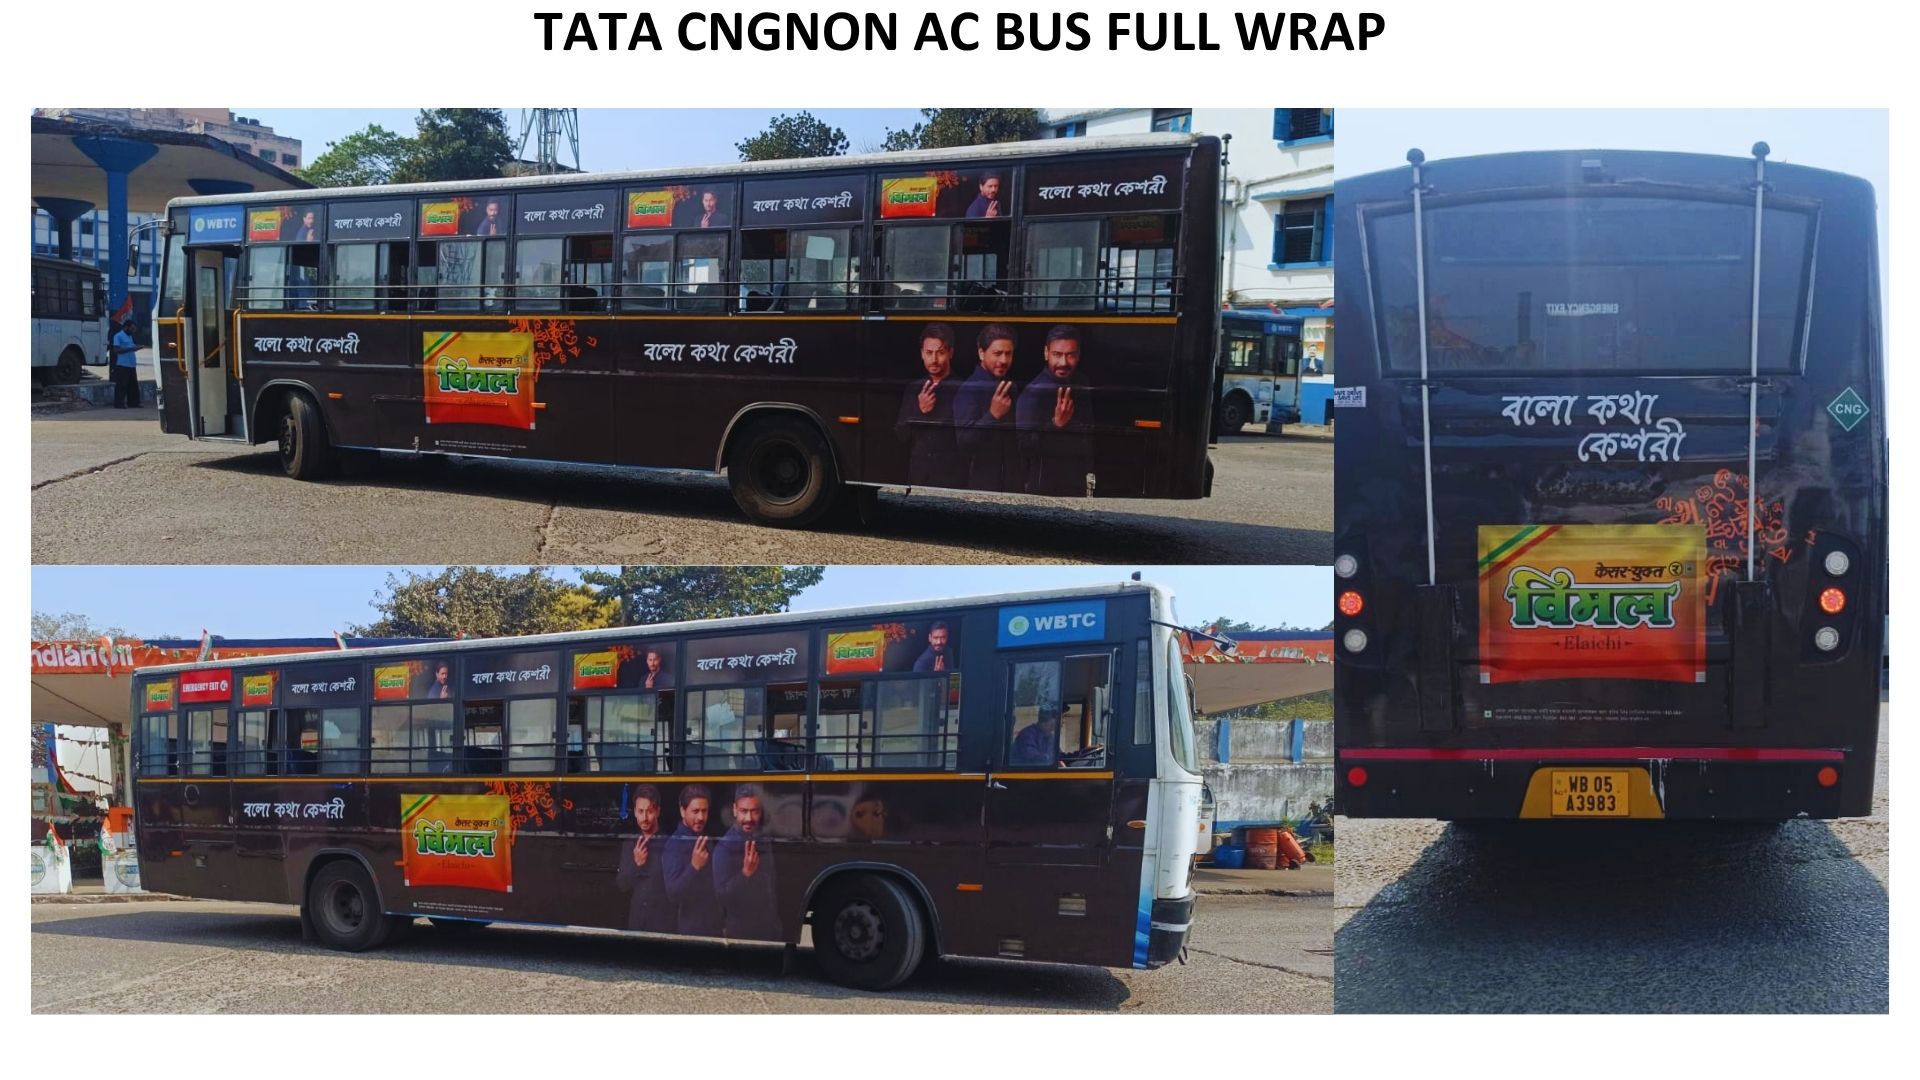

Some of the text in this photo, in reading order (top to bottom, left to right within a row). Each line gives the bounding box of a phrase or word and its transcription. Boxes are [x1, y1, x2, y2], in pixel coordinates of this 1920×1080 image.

[1039, 175, 1168, 200] বলো কথা কেশরী
[753, 191, 853, 212] বলো কথা কেশরী
[334, 212, 402, 229] বলো কথা কেশরী
[524, 203, 605, 222] বলো কথা কেশরী
[207, 217, 237, 230] WBTC
[254, 332, 360, 354] বলো কথা কেশরী
[644, 337, 798, 364] বলো কথা কেশরী
[1502, 390, 1658, 426] বলো কথা
[1835, 403, 1862, 415] CNG
[1578, 417, 1686, 462] কেশরী
[1034, 612, 1096, 632] WBTC
[1564, 636, 1622, 650] Elaichi
[697, 648, 798, 671] বলো কথা কেশরী
[472, 665, 551, 684] বলো কথা কেশরী
[291, 677, 356, 694] বলো কথা কেশরী
[1569, 776, 1588, 793] WB
[1594, 776, 1613, 793] 05
[243, 797, 345, 819] বলো কথা কেশরী
[1566, 795, 1616, 811] A3983
